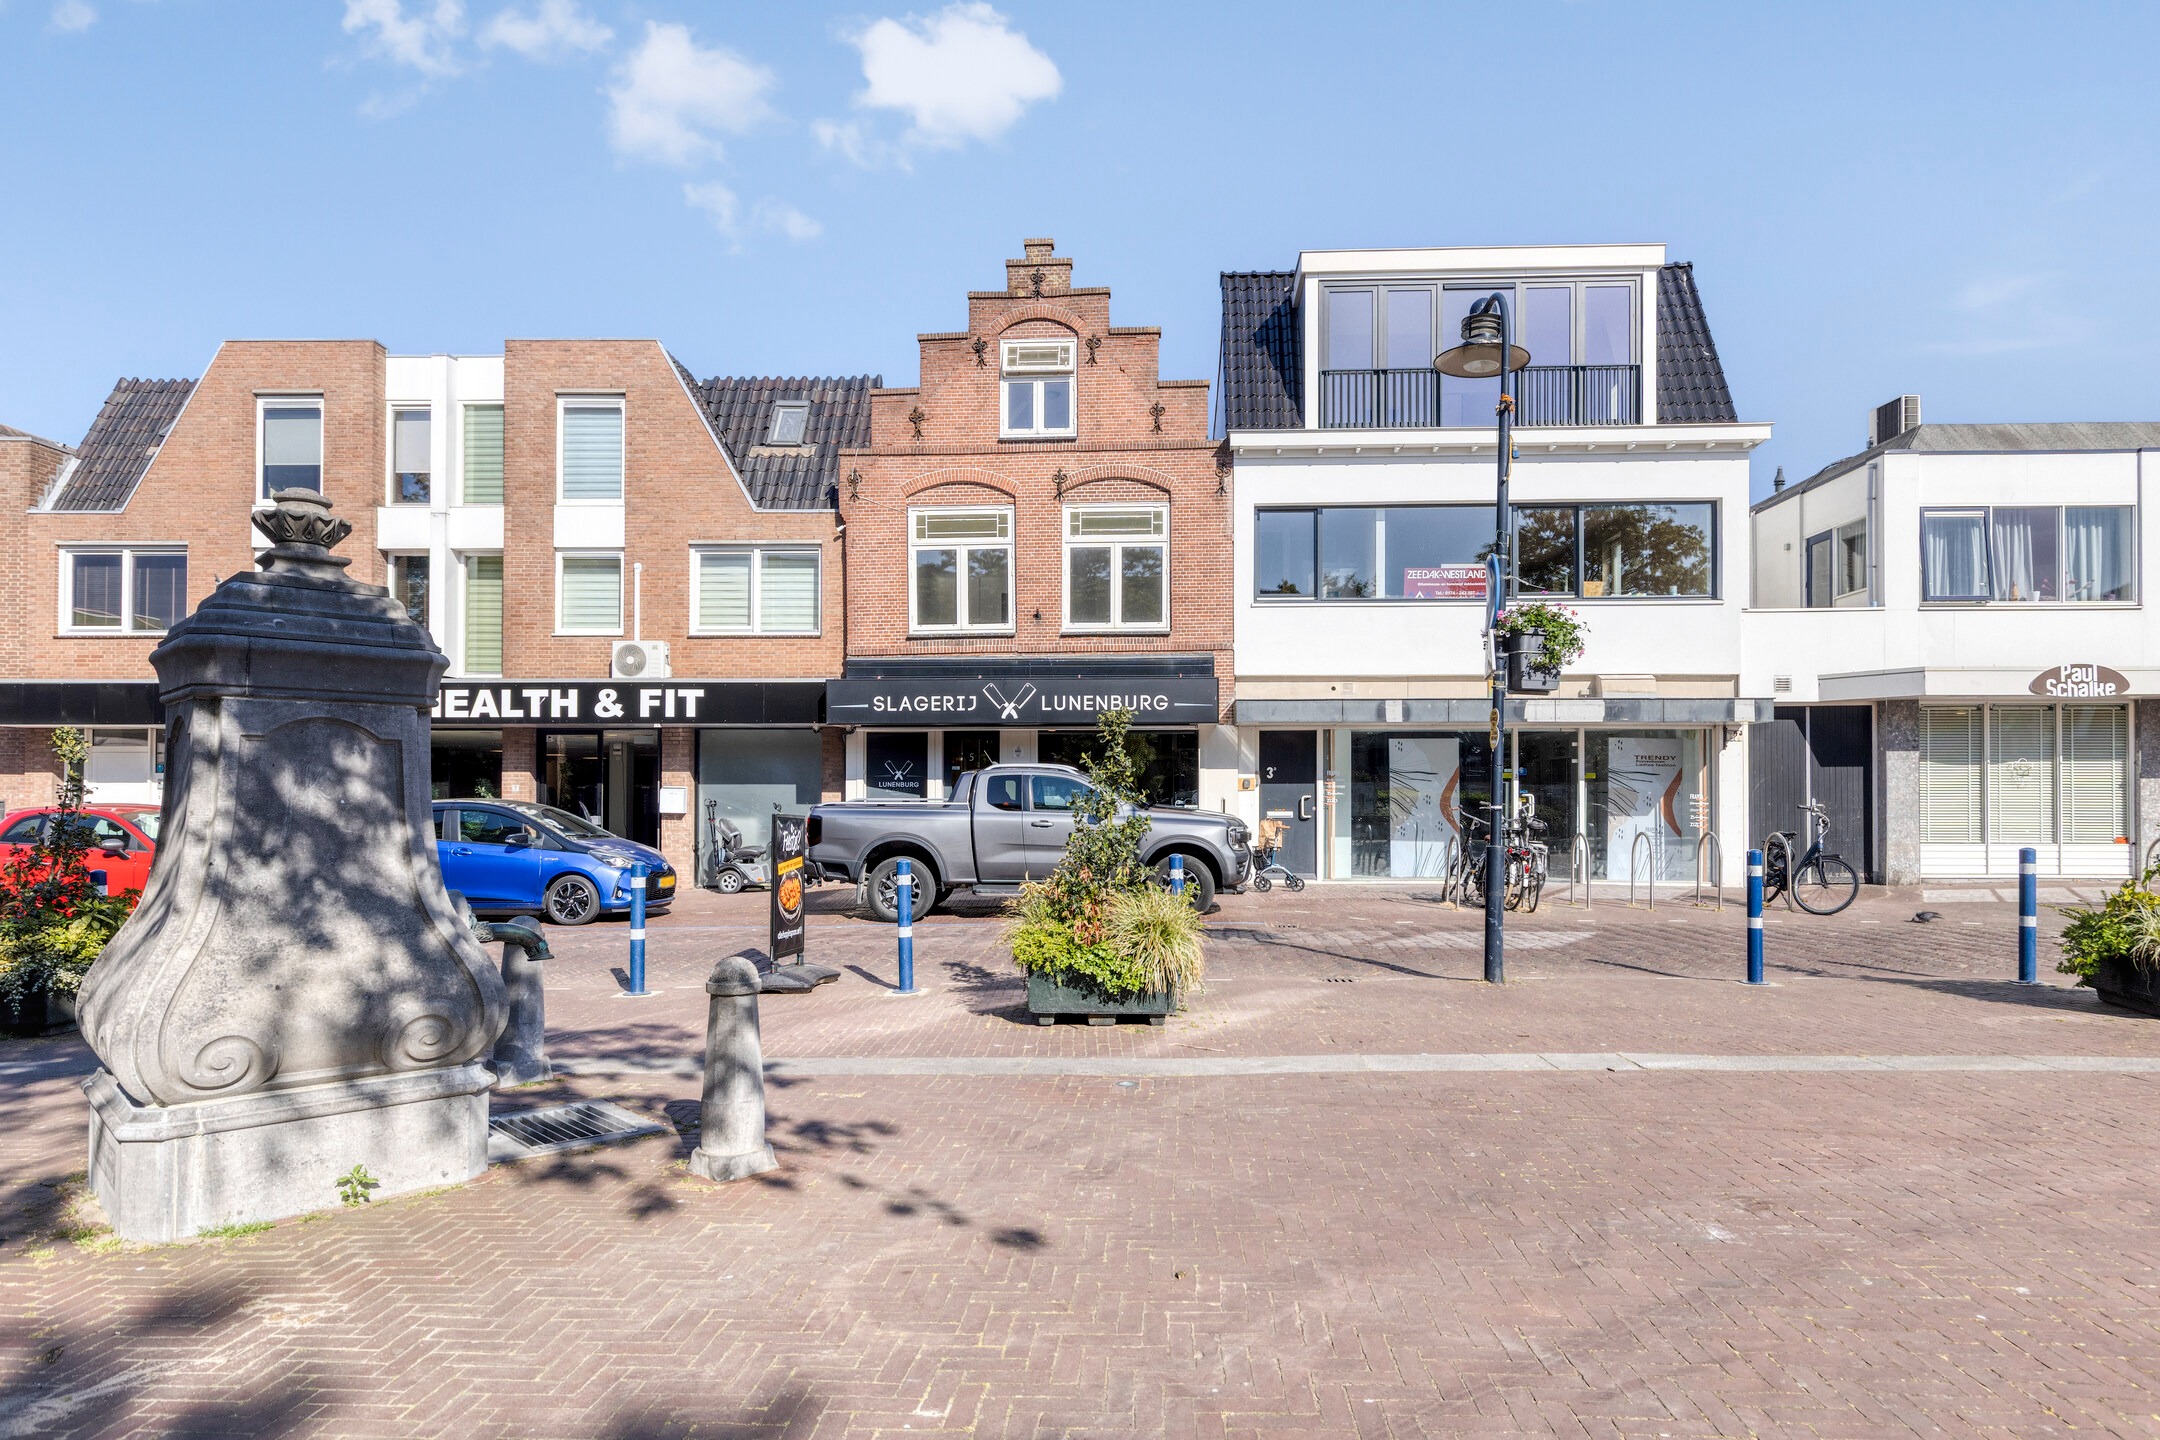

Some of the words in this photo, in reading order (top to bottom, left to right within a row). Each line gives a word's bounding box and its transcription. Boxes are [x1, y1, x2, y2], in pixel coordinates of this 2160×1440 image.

[2061, 664, 2098, 682] Paul
[2046, 678, 2117, 697] Schalke
[594, 688, 624, 718] &
[639, 689, 705, 718] FIT
[873, 696, 977, 712] SLAGERIJ
[1041, 694, 1169, 711] LUNENBURG
[969, 752, 975, 762] 5
